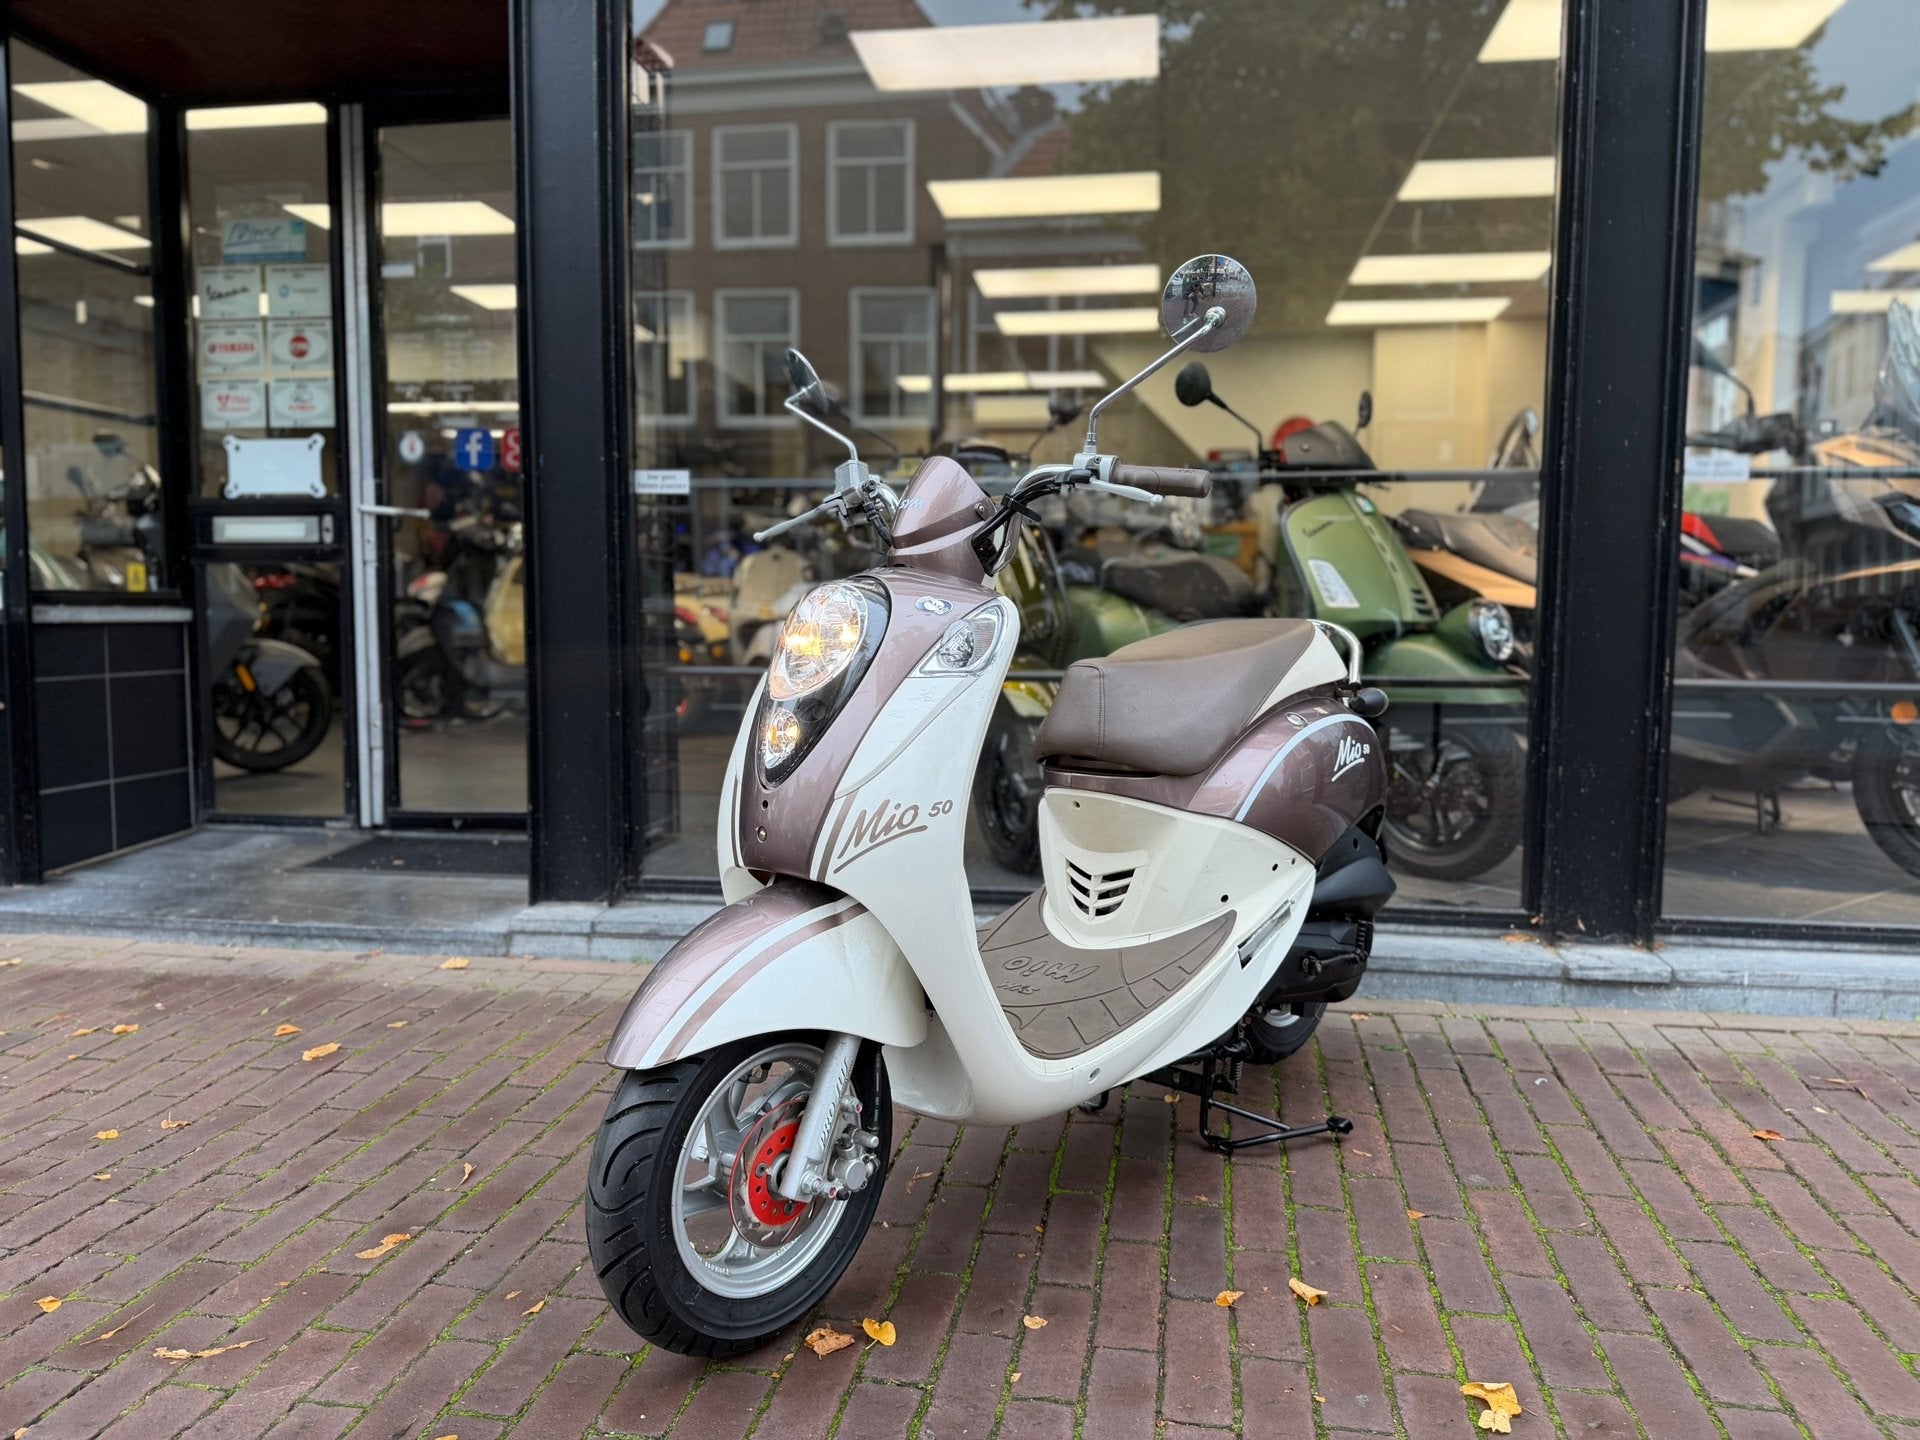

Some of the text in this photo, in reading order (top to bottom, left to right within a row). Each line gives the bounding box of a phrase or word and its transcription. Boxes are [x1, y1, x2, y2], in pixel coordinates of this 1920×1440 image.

[899, 498, 924, 510] SYM
[1333, 735, 1371, 772] Mio 50
[835, 799, 954, 862] Mio 50
